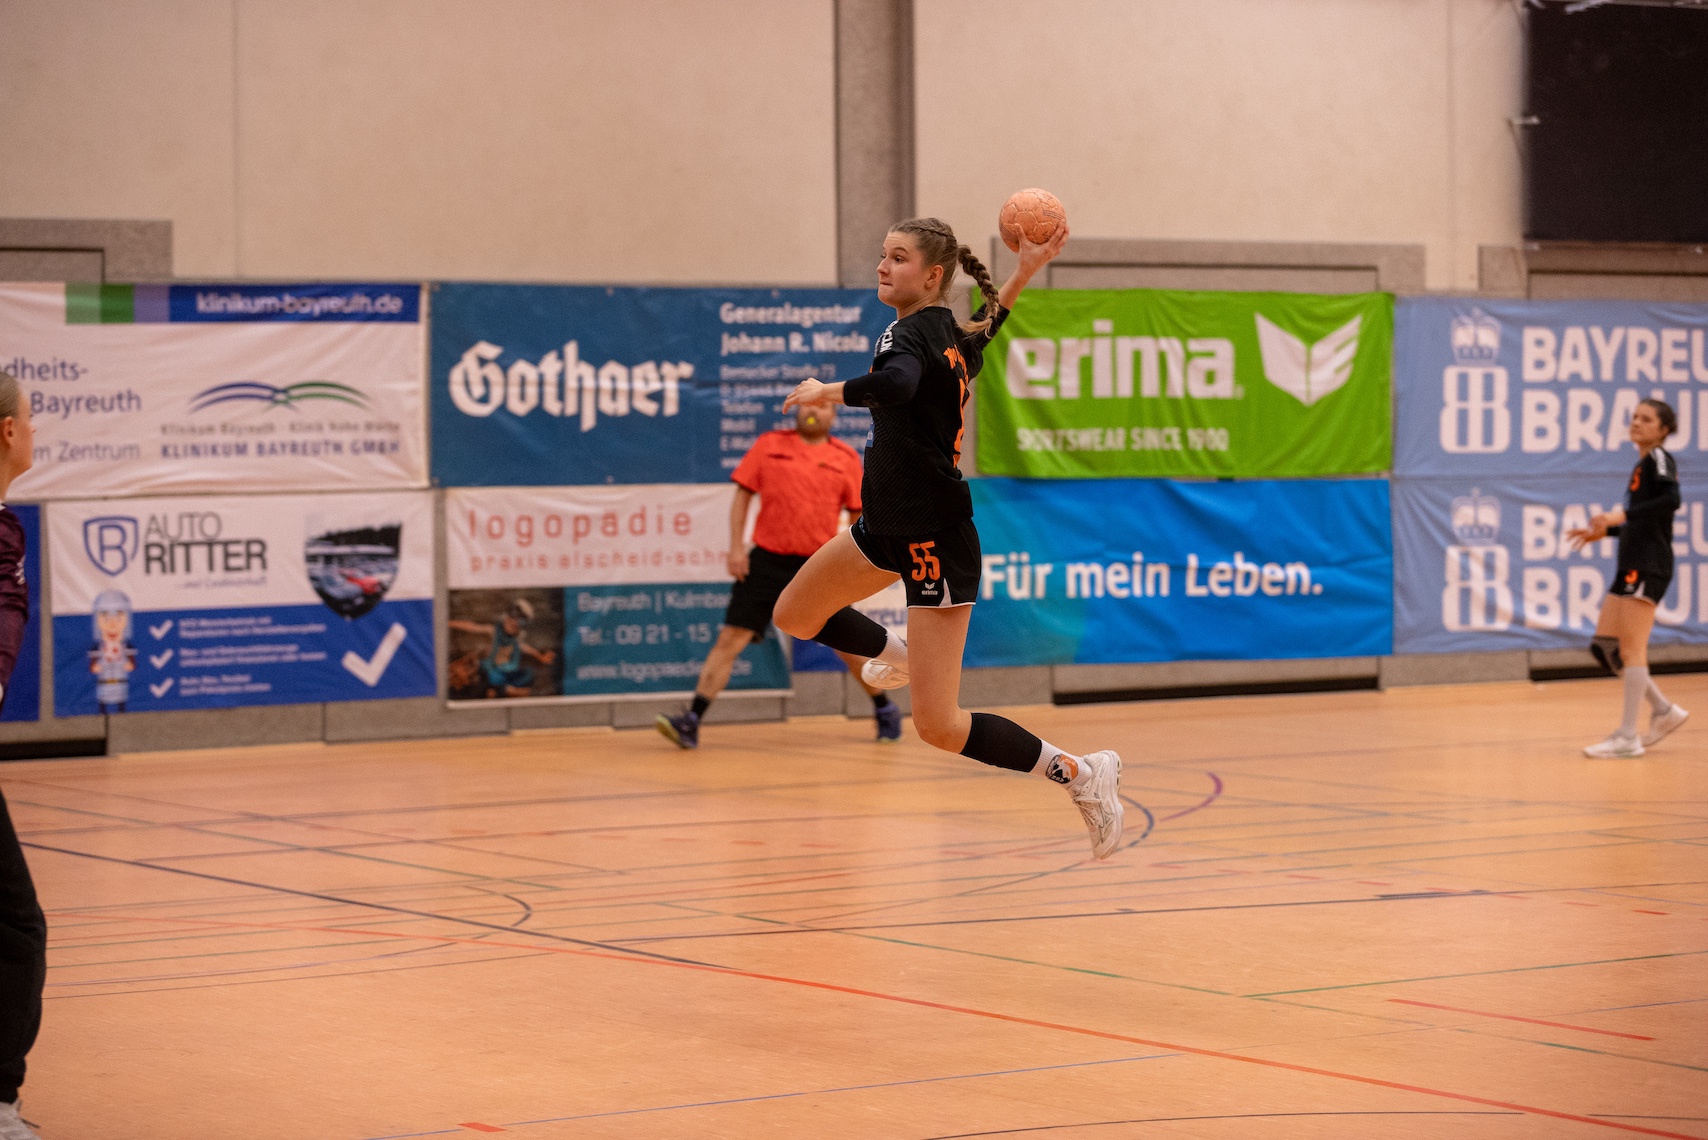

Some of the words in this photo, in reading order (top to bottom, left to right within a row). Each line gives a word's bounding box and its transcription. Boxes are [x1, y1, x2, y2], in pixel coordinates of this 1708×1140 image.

[719, 303, 862, 329] Generalagentur
[720, 333, 784, 356] Johann
[789, 332, 810, 353] R.
[813, 333, 869, 353] Nicola
[0, 357, 88, 381] dheits-
[1006, 319, 1237, 400] erima
[449, 340, 694, 432] Gothaer
[31, 389, 142, 419] Bayreuth
[1522, 388, 1708, 453] BRAU
[58, 440, 142, 463] Zentrum
[160, 442, 249, 459] KLINIKUM
[256, 440, 344, 457] BAYREUTH
[1016, 427, 1126, 453] SPORTSWEAR
[1131, 427, 1182, 452] SINCE
[146, 512, 223, 540] AUTO
[144, 539, 269, 574] RITTER
[908, 540, 941, 582] 55
[982, 552, 1053, 600] Für
[1065, 552, 1169, 599] mein
[1185, 553, 1323, 597] Leben.
[645, 624, 670, 644] 21
